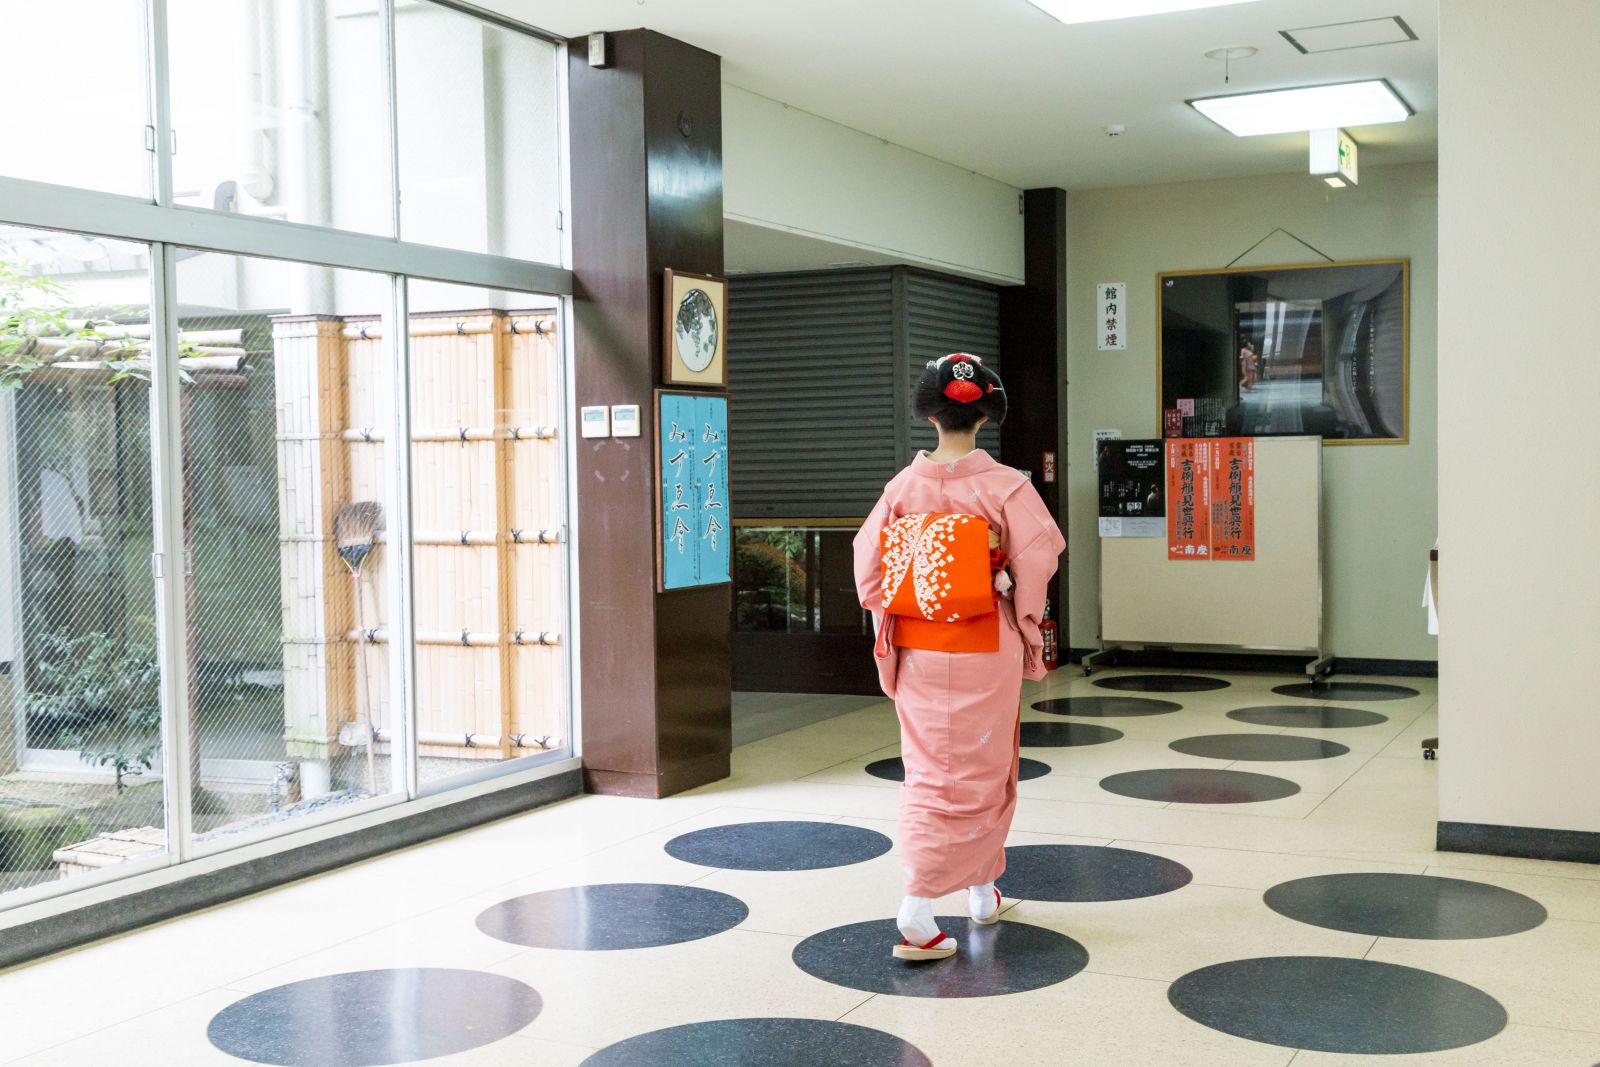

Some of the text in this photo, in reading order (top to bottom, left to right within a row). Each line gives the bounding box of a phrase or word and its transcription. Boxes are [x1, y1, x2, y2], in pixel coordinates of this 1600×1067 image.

[1105, 287, 1118, 346] 館内禁煙
[1045, 453, 1054, 482] 消火器
[1185, 544, 1208, 555] 南座
[1229, 544, 1252, 555] 南座
